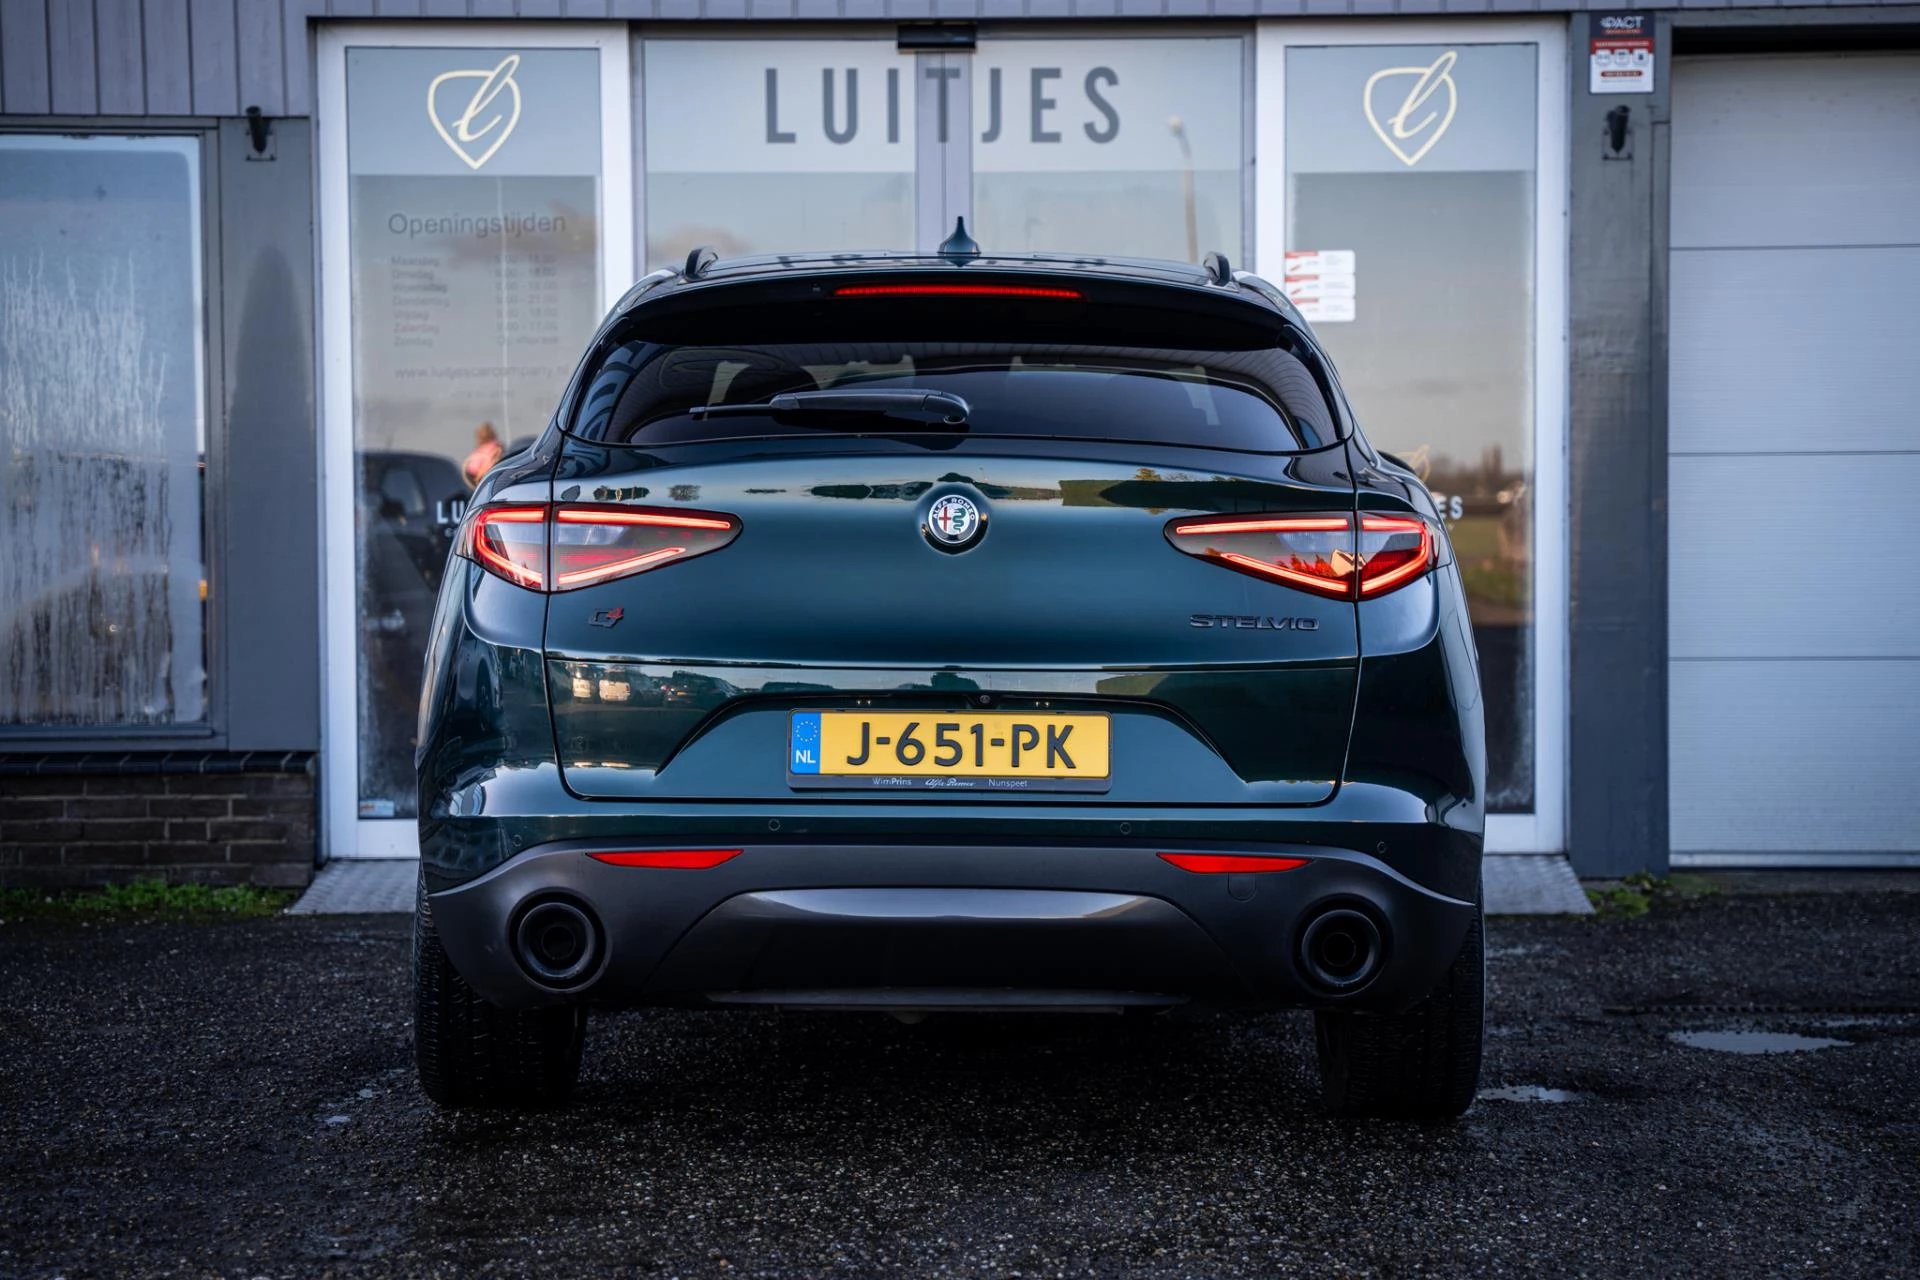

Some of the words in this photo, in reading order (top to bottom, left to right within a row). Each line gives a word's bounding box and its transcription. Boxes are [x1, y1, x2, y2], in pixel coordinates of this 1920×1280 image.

[765, 66, 1120, 144] LUITJES
[388, 212, 566, 238] Openingstijden
[933, 500, 948, 519] ALFA
[951, 498, 975, 520] ROMEO
[1190, 614, 1320, 631] STELVIO
[846, 722, 1077, 769] J-651-PK
[795, 750, 816, 764] NL
[988, 778, 1028, 788] Nunspeet
